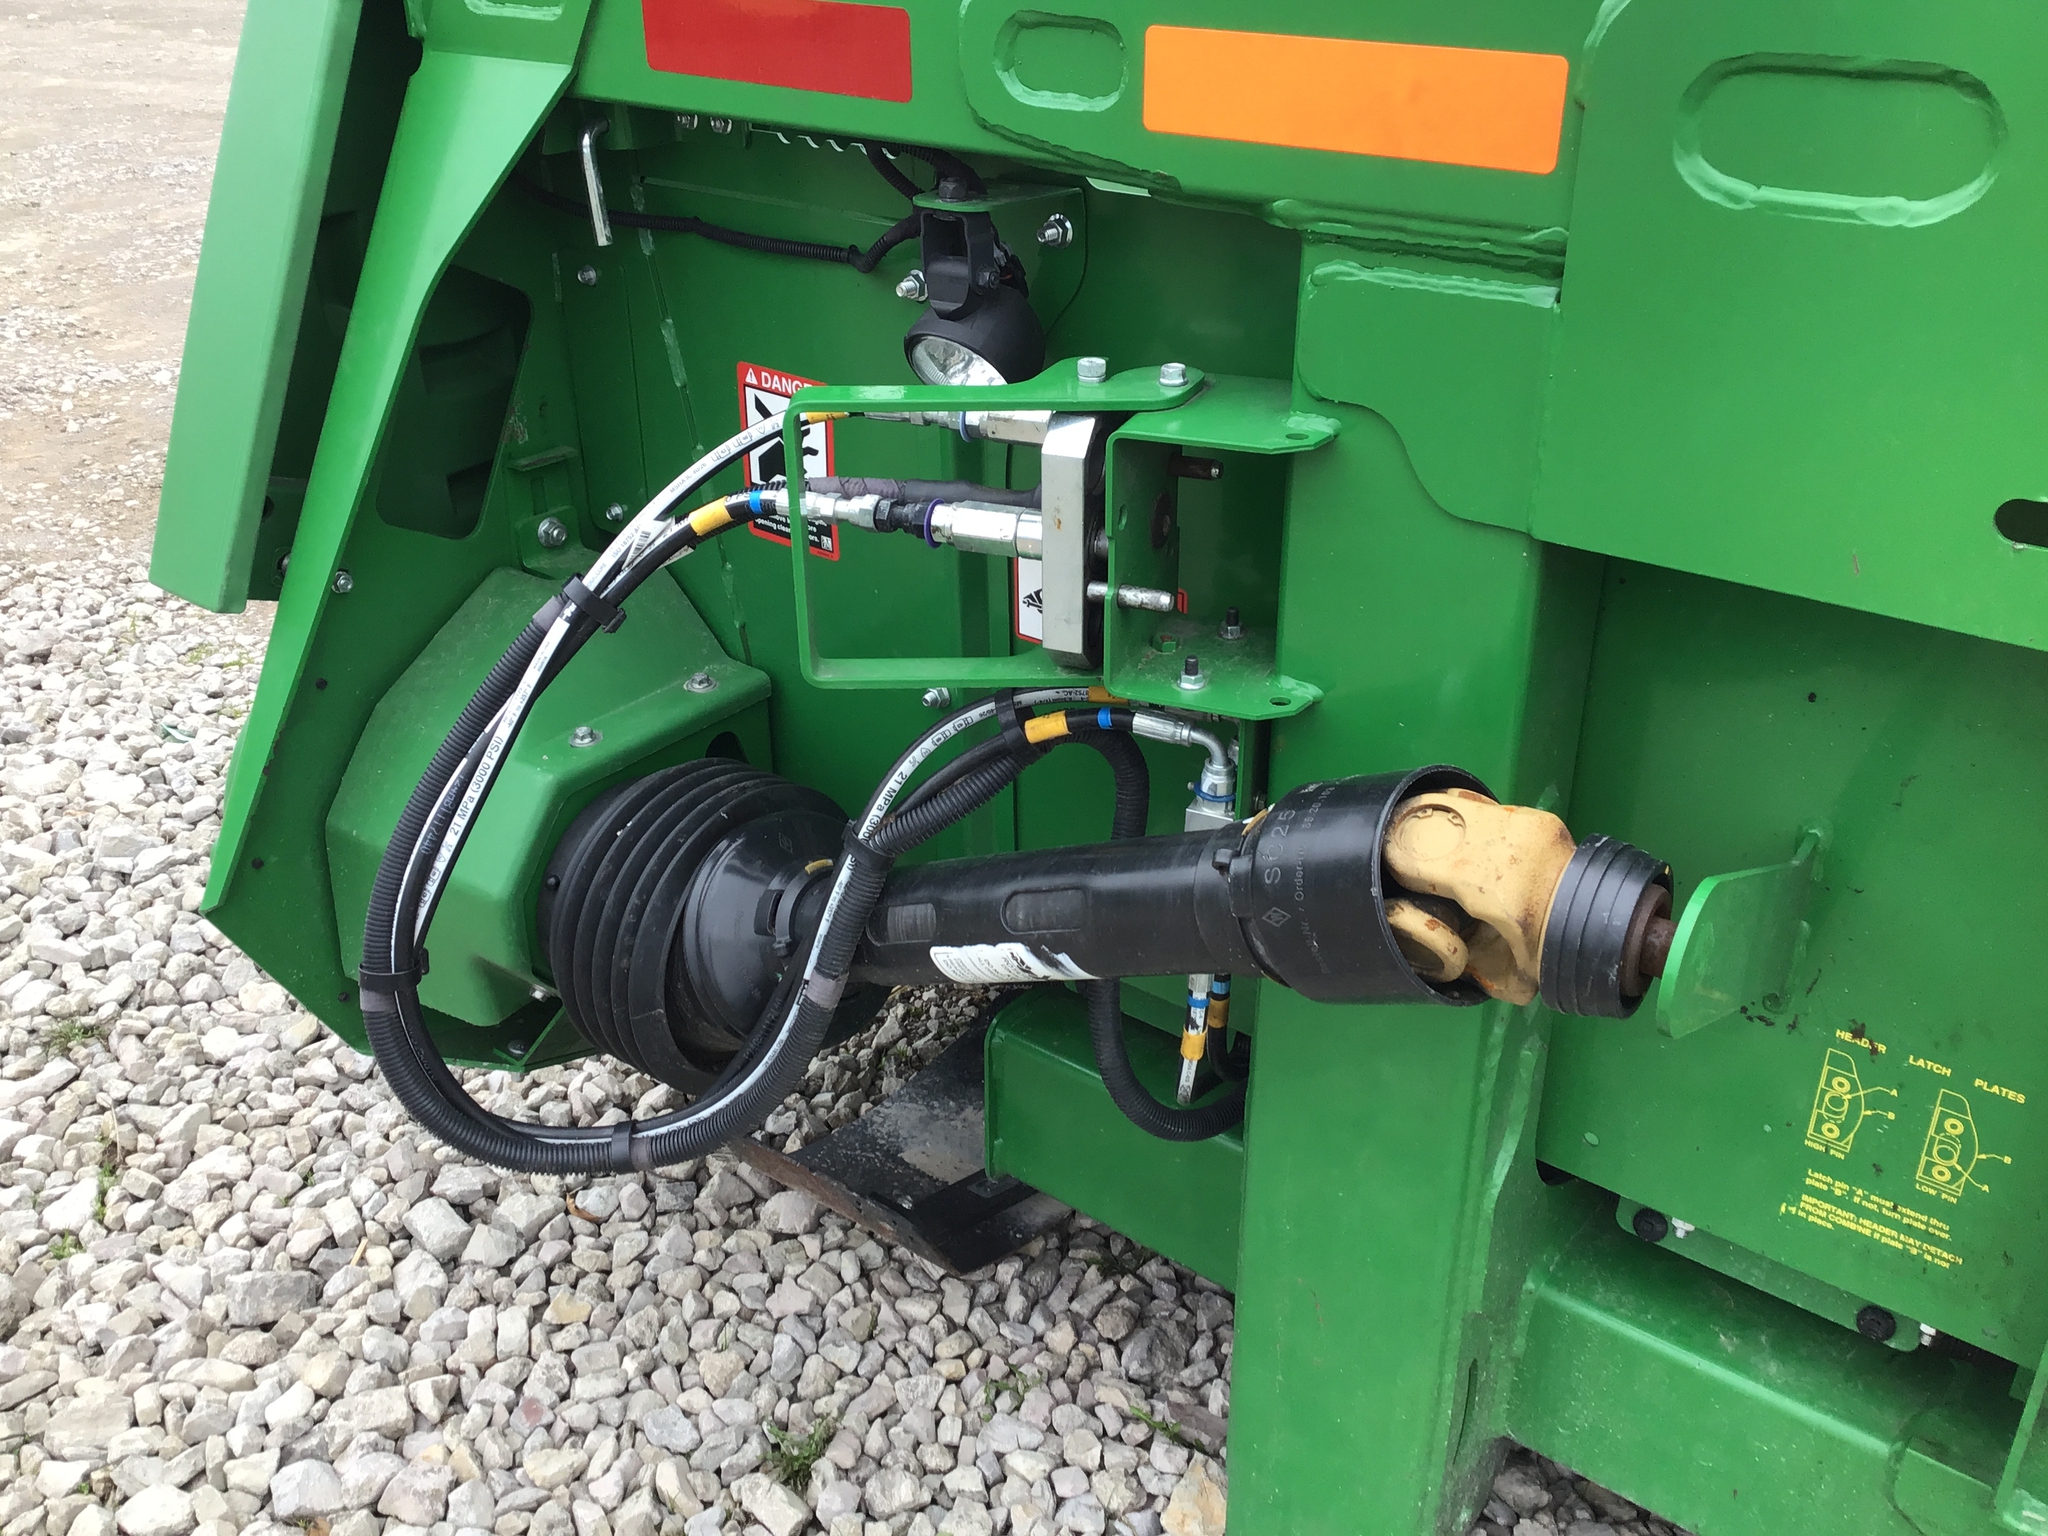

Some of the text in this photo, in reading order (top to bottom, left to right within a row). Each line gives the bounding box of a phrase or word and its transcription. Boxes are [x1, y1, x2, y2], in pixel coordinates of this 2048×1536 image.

[760, 371, 813, 395] DANG
[450, 735, 505, 838] 21 MPa (3000 PSI)
[896, 771, 908, 785] 21
[876, 786, 898, 813] MPa
[1835, 1029, 1887, 1055] HEDR
[1908, 1054, 1952, 1078] LATCH
[1890, 1089, 1898, 1098] A
[1974, 1078, 2027, 1105] PLATES
[1887, 1111, 1896, 1121] B
[1804, 1139, 1846, 1161] HIGH PIN
[2003, 1155, 2013, 1165] B
[1807, 1168, 1834, 1185] Latch
[1834, 1180, 1850, 1191] pin
[1869, 1194, 1895, 1209] must
[1929, 1216, 1950, 1231] thru
[1915, 1182, 1959, 1205] LOW PIN
[1981, 1184, 1990, 1194] A
[1797, 1208, 1808, 1219] in
[1805, 1177, 1829, 1191] plate
[1882, 1206, 1901, 1221] turn
[1902, 1216, 1927, 1232] plate
[1799, 1201, 1828, 1219] FROM
[1828, 1213, 1873, 1237] COMBINE
[1881, 1235, 1904, 1250] plate
[1934, 1256, 1951, 1270] not
[1801, 1193, 1964, 1266] IMPORTANT: HEADER MAY DETACH
